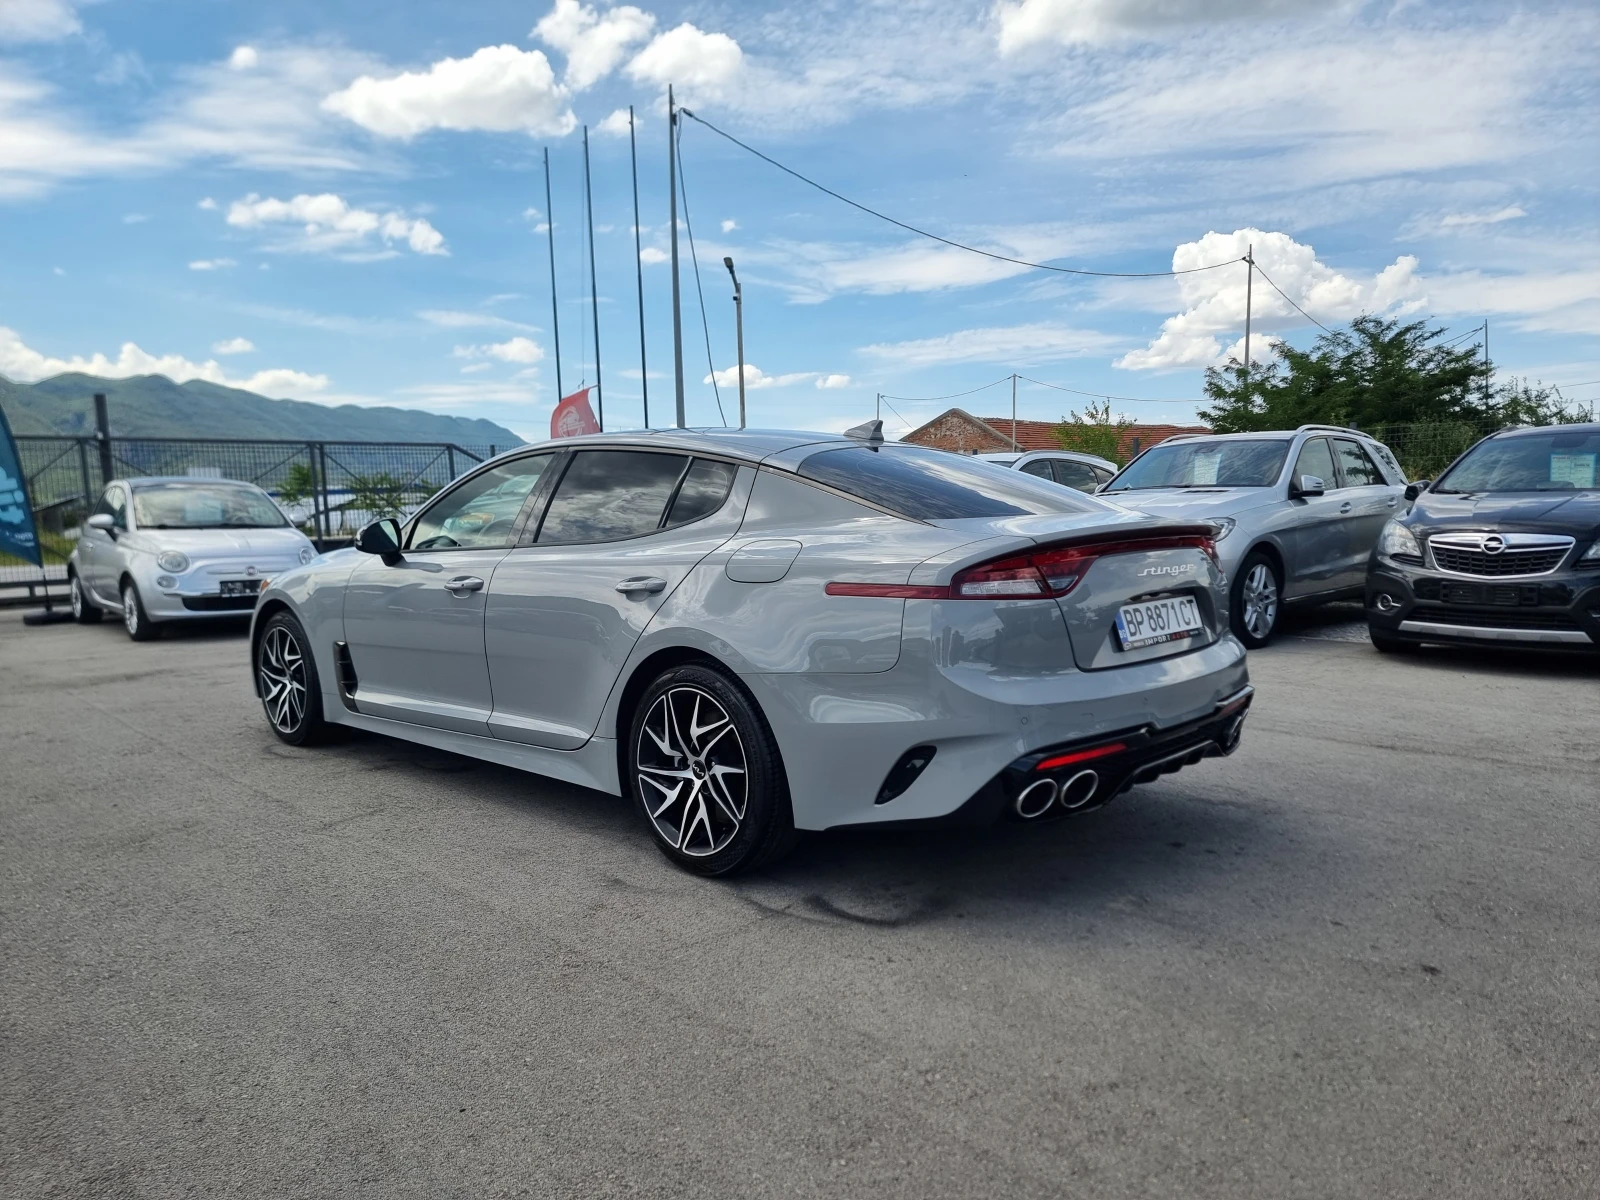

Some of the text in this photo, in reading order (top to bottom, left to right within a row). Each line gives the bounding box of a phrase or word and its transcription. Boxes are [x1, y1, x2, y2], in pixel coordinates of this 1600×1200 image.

[1123, 599, 1197, 637] BP 8871 CT
[1145, 634, 1171, 645] IMPORT
